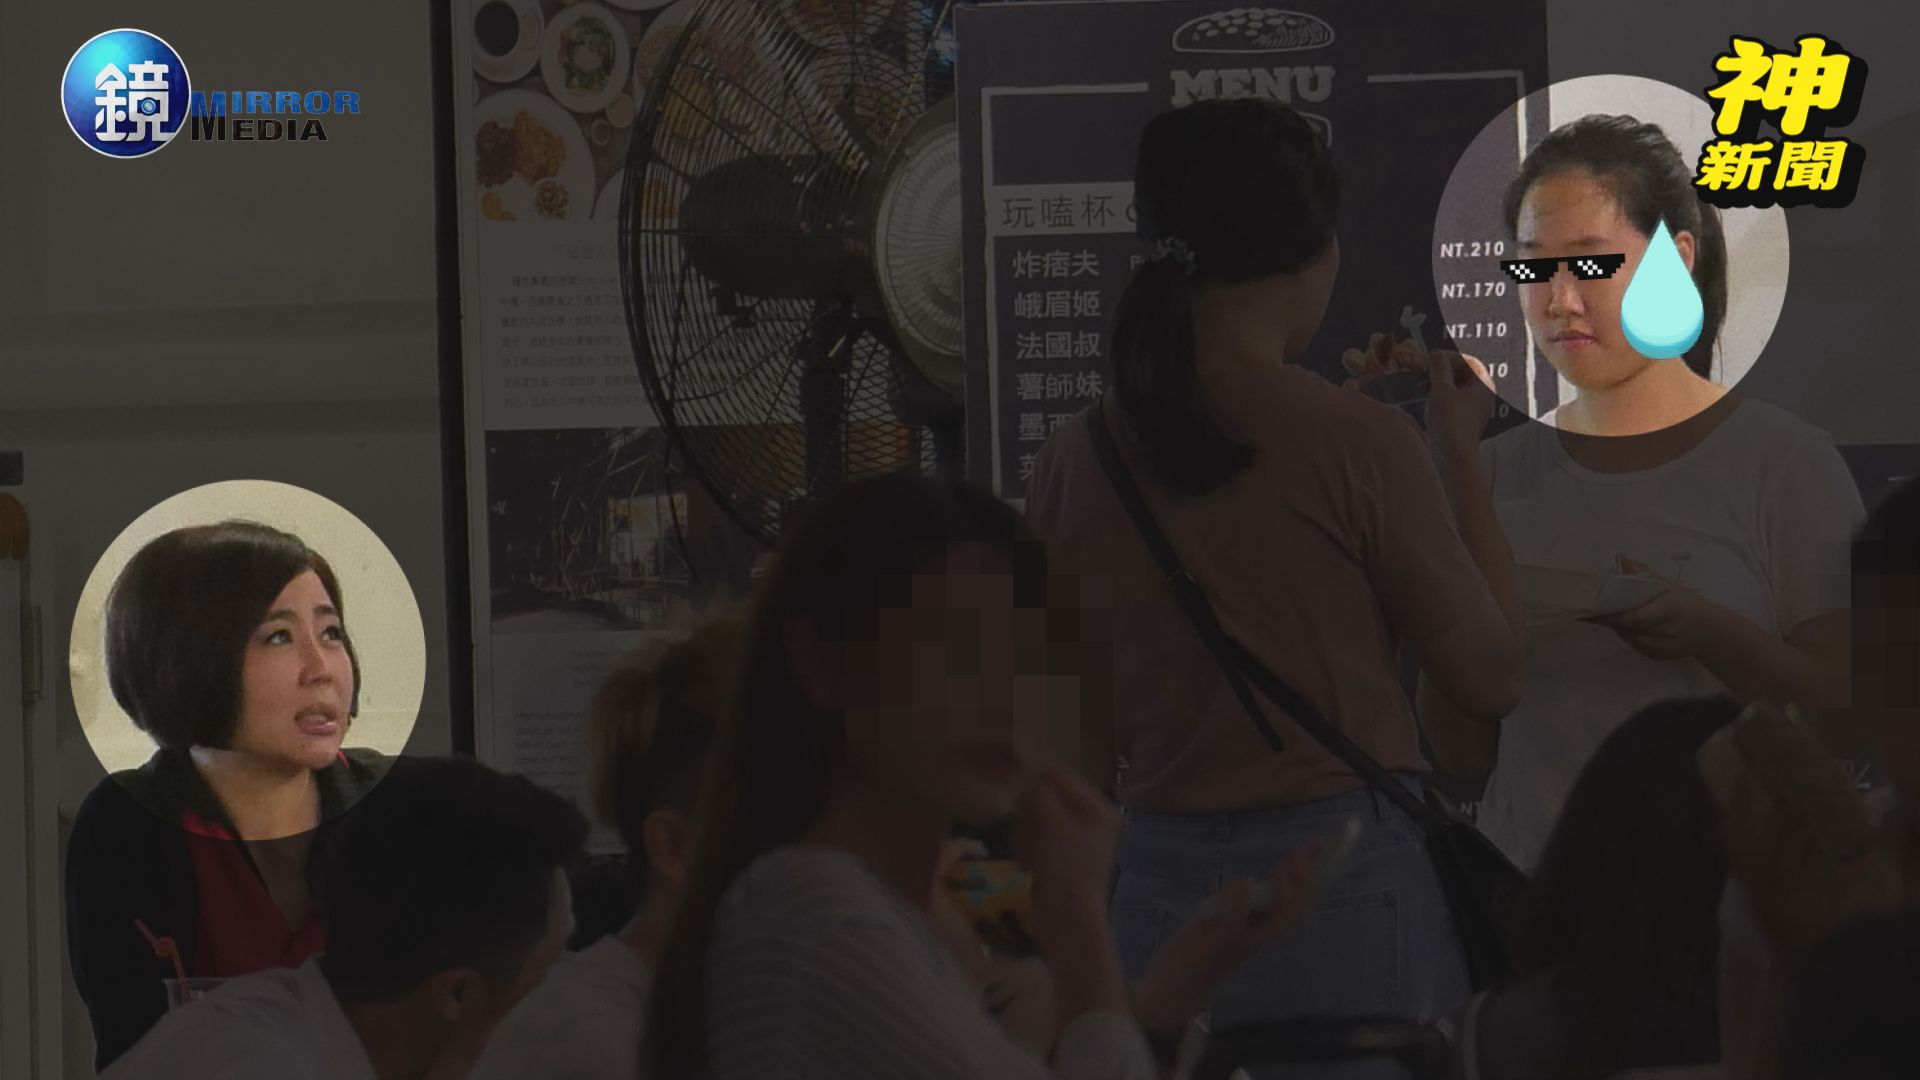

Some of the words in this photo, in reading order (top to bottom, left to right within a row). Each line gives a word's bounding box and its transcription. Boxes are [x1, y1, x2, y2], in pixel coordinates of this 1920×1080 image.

[1170, 65, 1336, 107] MENU
[1002, 194, 1115, 228] 玩嗑杯
[1440, 241, 1504, 258] NT.210
[1014, 290, 1102, 319] 峨眉姬
[1442, 282, 1506, 298] NT.170
[1443, 322, 1508, 339] NT.110
[1015, 331, 1103, 360] 法國叔
[1016, 371, 1104, 401] 薯師妹
